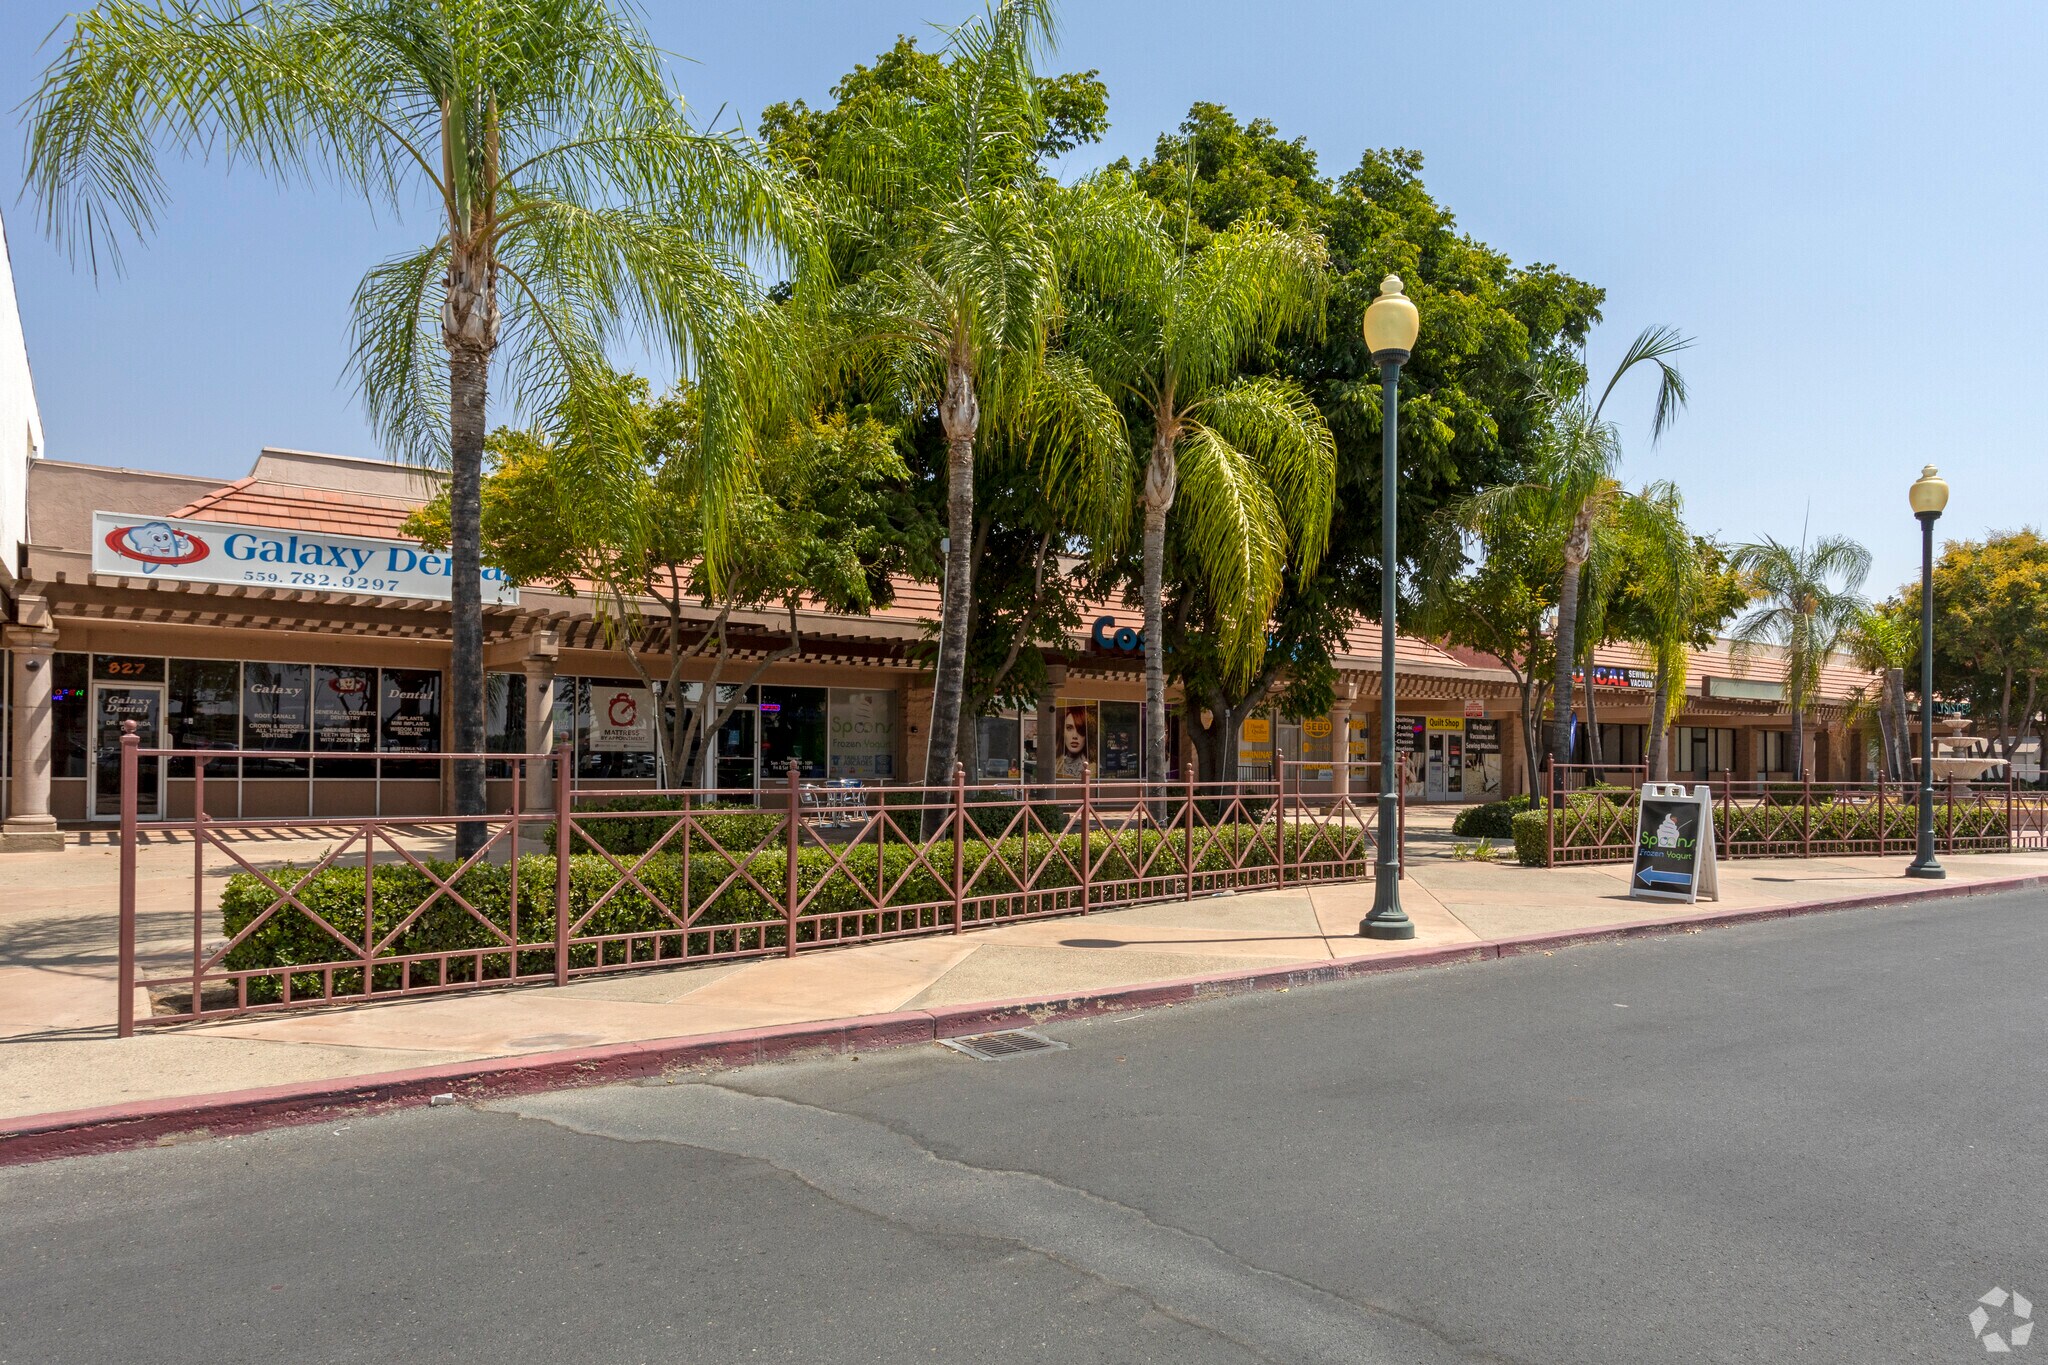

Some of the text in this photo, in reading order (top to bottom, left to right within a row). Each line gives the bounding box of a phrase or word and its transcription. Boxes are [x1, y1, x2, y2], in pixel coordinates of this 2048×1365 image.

[224, 533, 511, 582] Galaxy Dea
[108, 662, 145, 674] 827
[1628, 669, 1650, 679] SEWING
[1630, 679, 1653, 688] VACUUM
[251, 684, 302, 697] Galaxy
[388, 690, 434, 699] Dental
[108, 696, 152, 705] Galaxy
[106, 704, 149, 713] Dental
[1305, 722, 1330, 731] SEBO
[1429, 718, 1460, 728] Quilt Shop
[833, 739, 862, 748] Frozen
[1466, 742, 1480, 750] Sewing
[1641, 831, 1696, 849] Spoons
[1640, 848, 1692, 860] Frozen Yogurt
